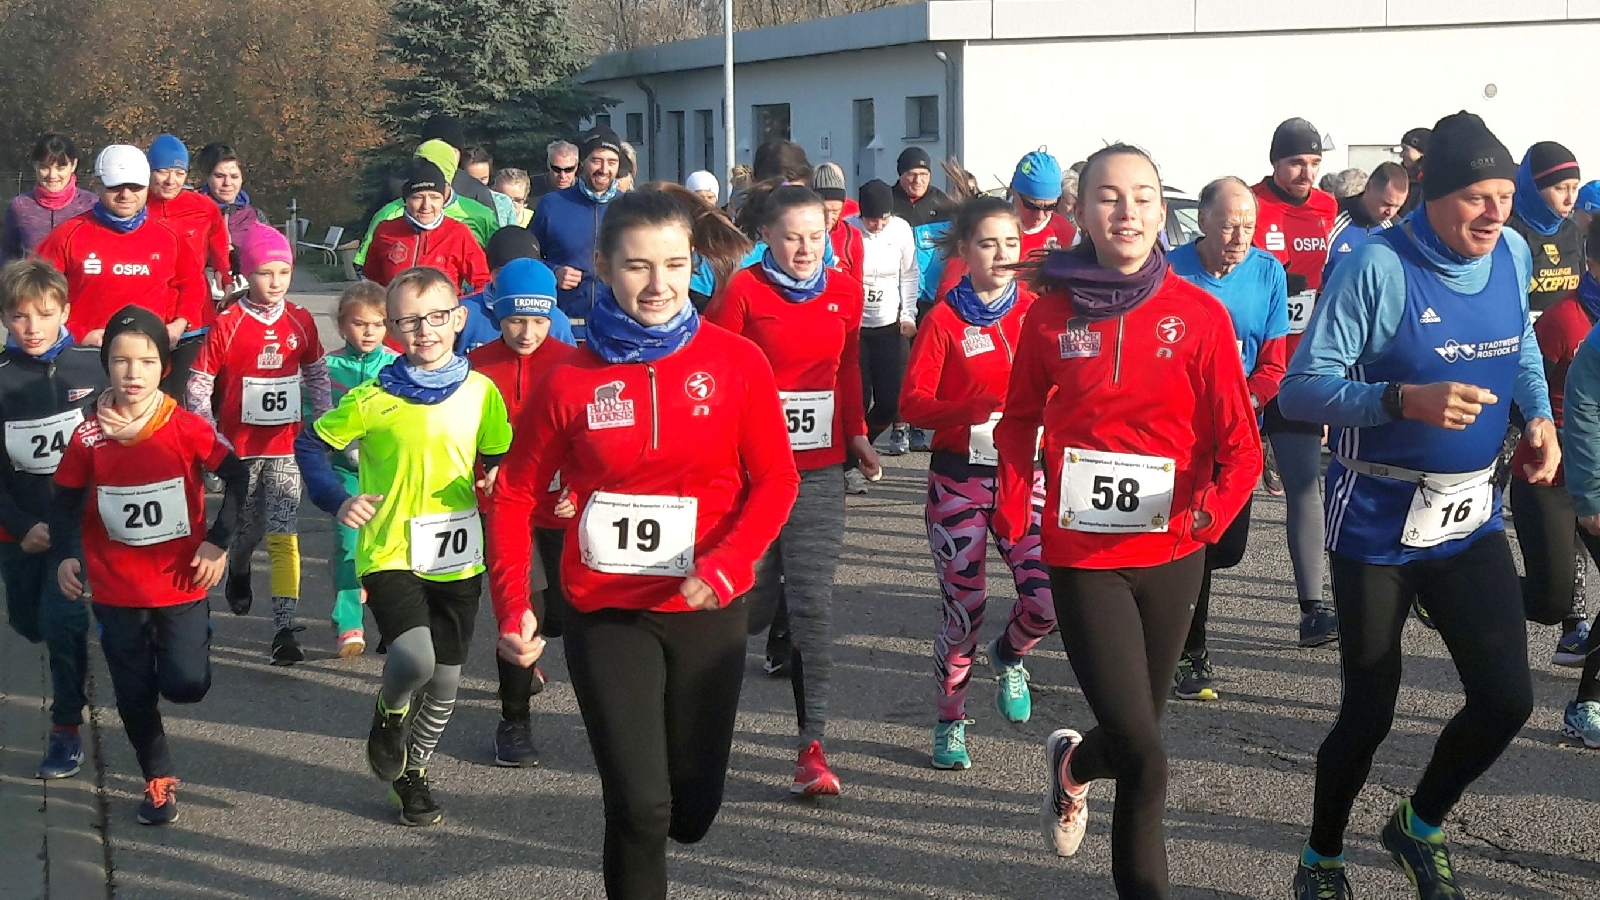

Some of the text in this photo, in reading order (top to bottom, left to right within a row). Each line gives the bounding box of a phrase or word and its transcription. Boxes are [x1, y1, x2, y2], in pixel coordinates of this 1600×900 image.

[1470, 157, 1495, 167] GORE
[1293, 238, 1327, 252] OSPA
[112, 263, 150, 276] OSPA
[867, 290, 884, 303] 52
[1061, 342, 1099, 353] HOUSE
[1477, 346, 1511, 358] ROSTOCK
[262, 391, 287, 412] 65
[590, 411, 634, 423] HOUSE
[786, 408, 815, 434] 55
[31, 429, 67, 459] 24
[1091, 475, 1140, 512] 58
[123, 501, 163, 528] 20
[1440, 497, 1473, 528] 16
[435, 528, 468, 558] 70
[612, 517, 661, 552] 19
